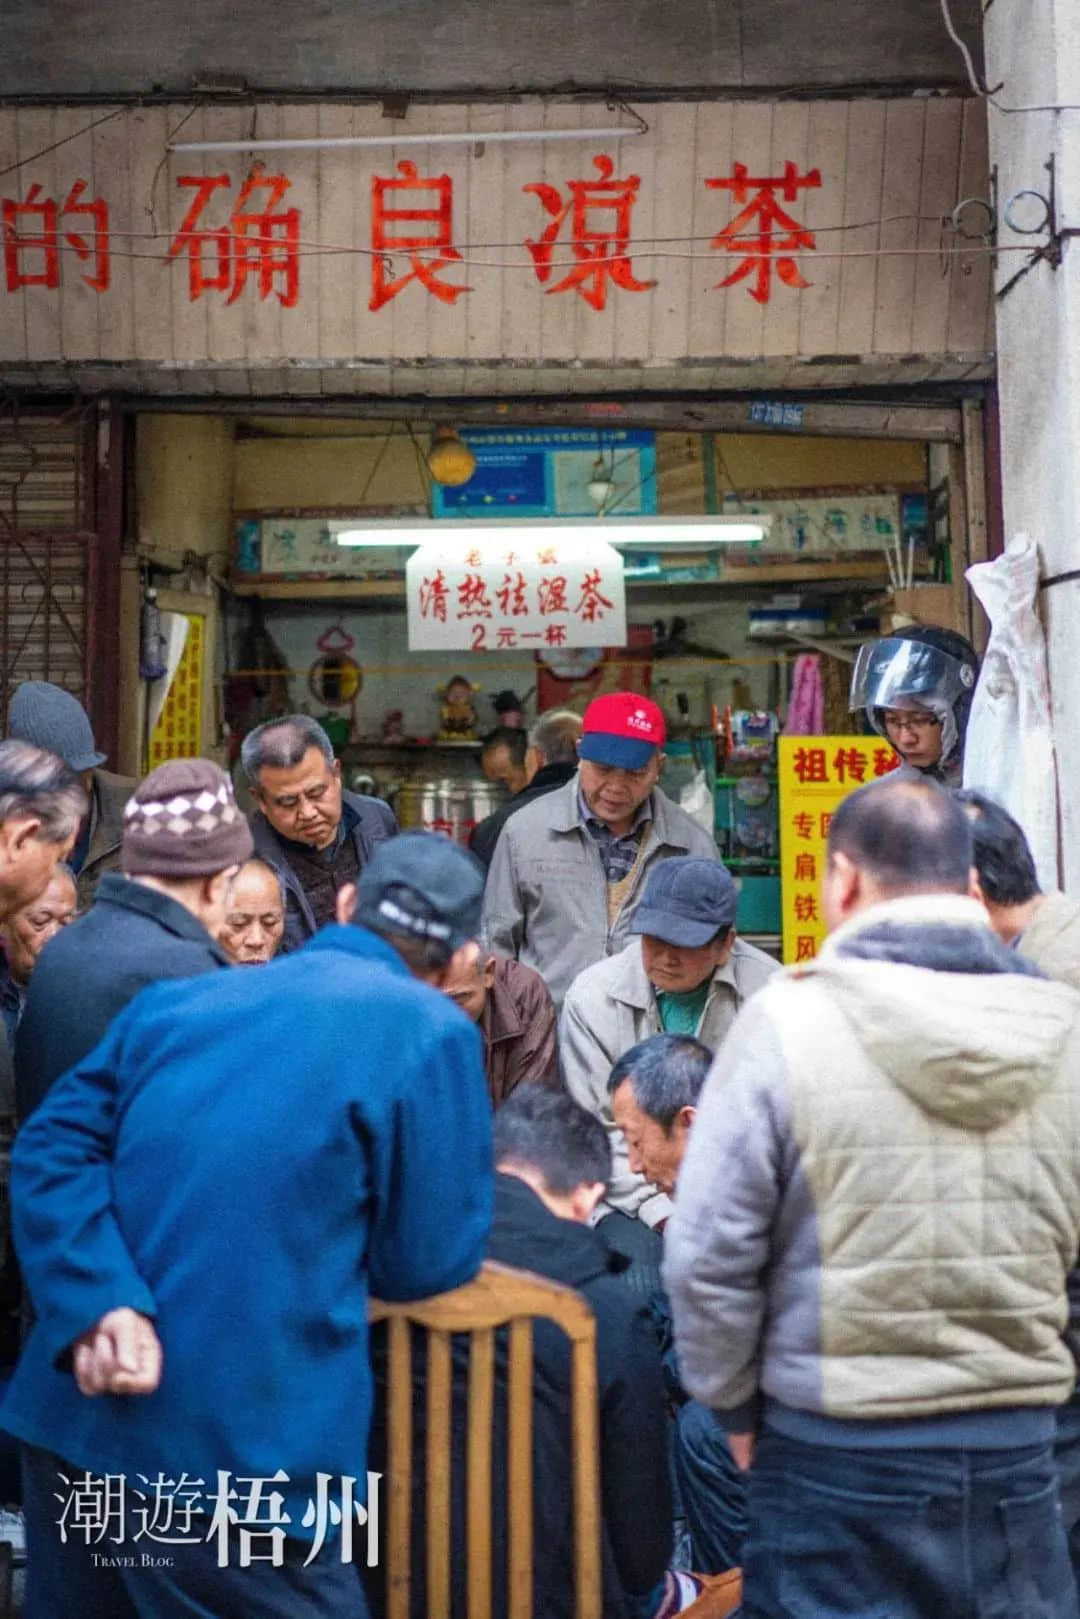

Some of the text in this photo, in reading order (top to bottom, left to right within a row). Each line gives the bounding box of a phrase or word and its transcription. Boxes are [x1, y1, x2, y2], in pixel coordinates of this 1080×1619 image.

[3, 157, 822, 312] 的确良凉茶
[419, 569, 614, 624] 清热祛湿茶
[471, 623, 567, 651] 2元一杯
